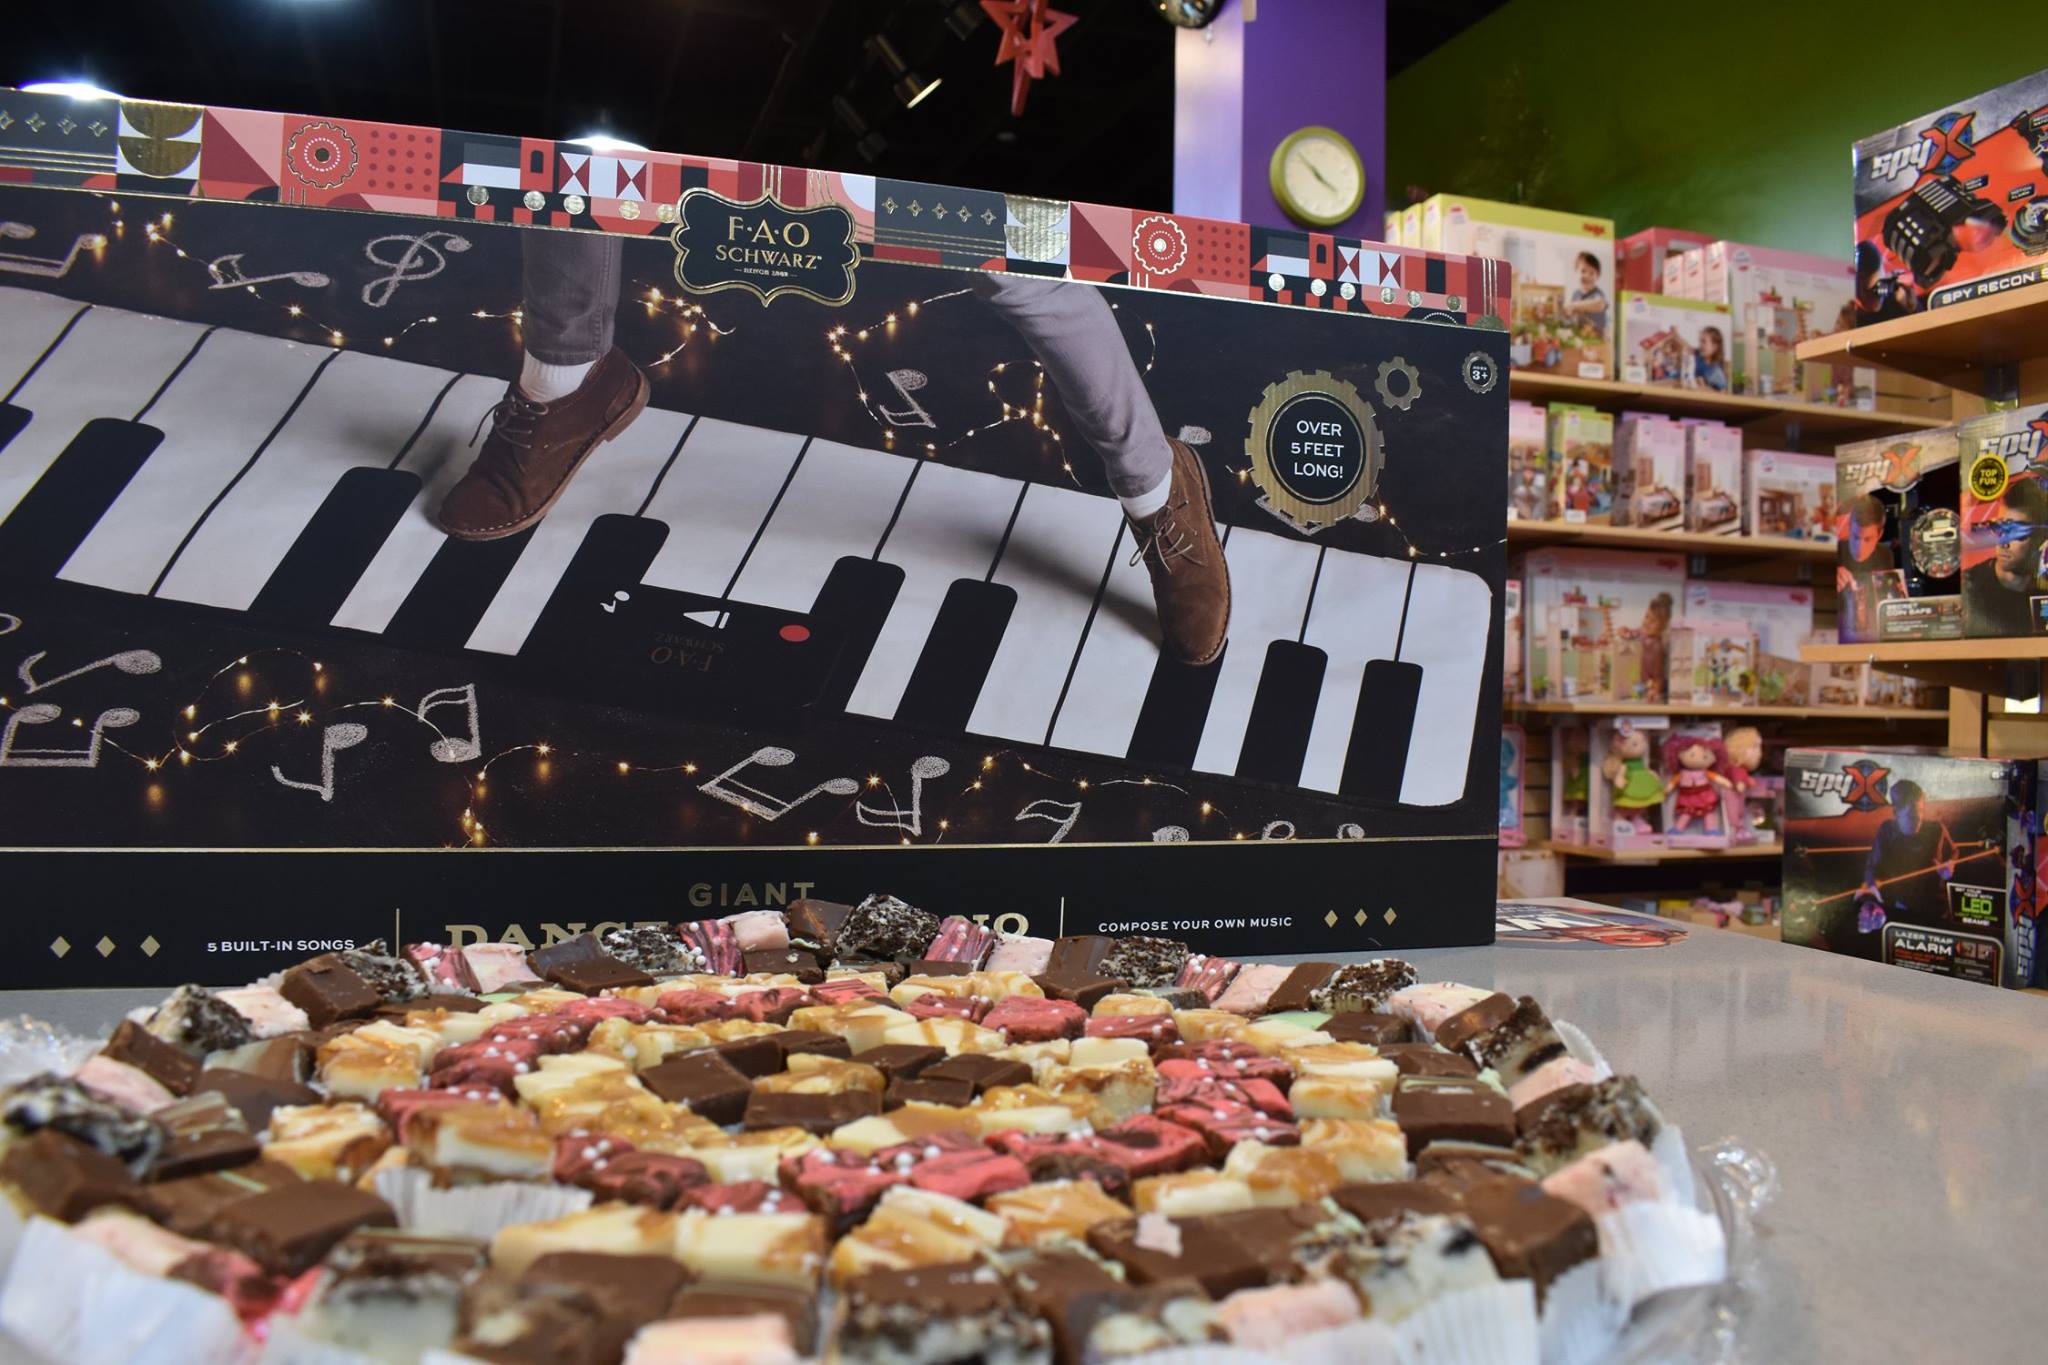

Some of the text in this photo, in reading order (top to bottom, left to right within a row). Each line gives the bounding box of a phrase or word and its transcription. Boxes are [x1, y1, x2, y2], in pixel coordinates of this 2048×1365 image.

[1942, 288, 1972, 305] SPY
[1977, 272, 2035, 296] RECON
[1472, 370, 1488, 380] 3+
[1296, 420, 1342, 437] OVER
[1291, 442, 1344, 458] 5 FEET
[1294, 462, 1344, 479] LONG!
[1980, 469, 1998, 478] TOP
[1979, 477, 1998, 487] FUN
[687, 881, 816, 908] GIANT
[1961, 896, 1992, 915] LED
[1098, 917, 1293, 933] COMPOSE YOUR OWN MUSIC
[445, 920, 669, 951] DANC
[1895, 930, 1926, 941] LAZER
[207, 939, 355, 952] 5 BUILT-IN SONGS
[1895, 938, 1953, 956] ALARM
